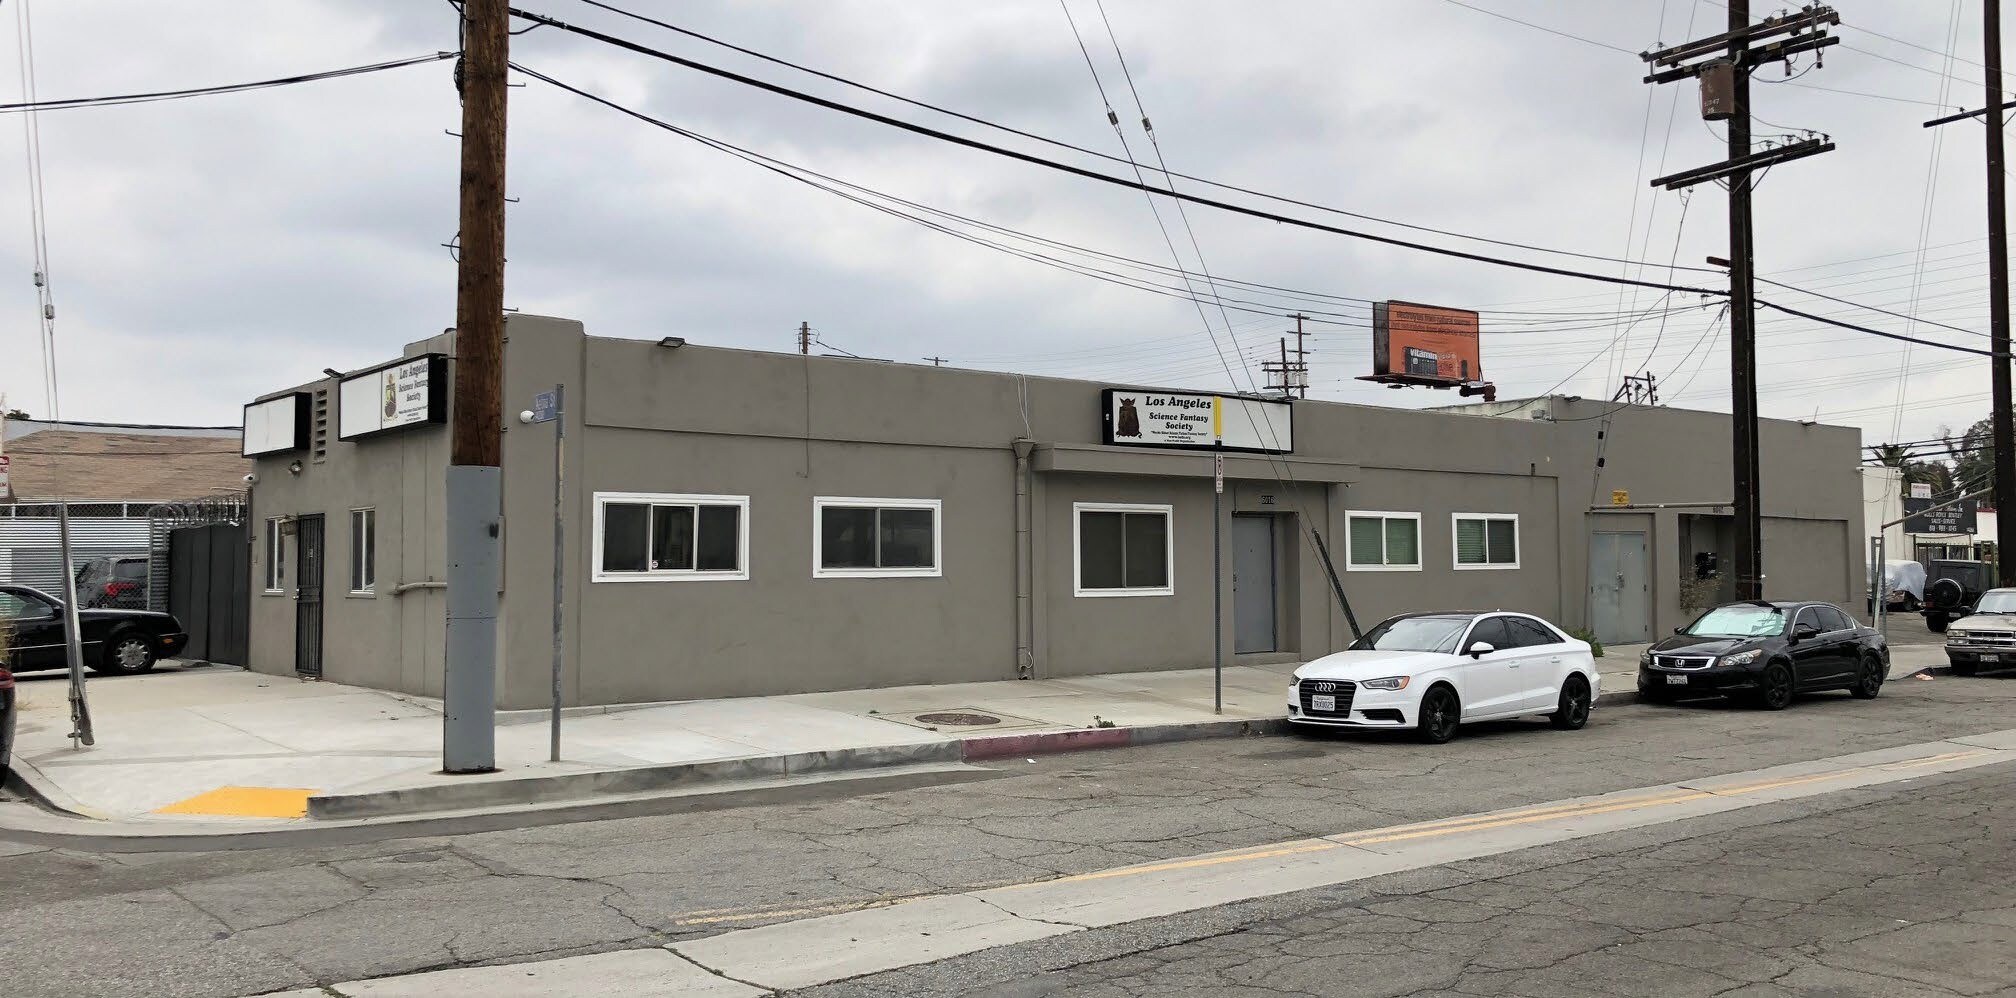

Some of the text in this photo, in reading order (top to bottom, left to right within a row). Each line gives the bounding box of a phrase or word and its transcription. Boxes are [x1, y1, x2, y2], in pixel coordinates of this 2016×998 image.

[1145, 396, 1212, 410] Los Angeles
[1149, 412, 1209, 423] Science Fantasy
[1165, 421, 1194, 431] Society
